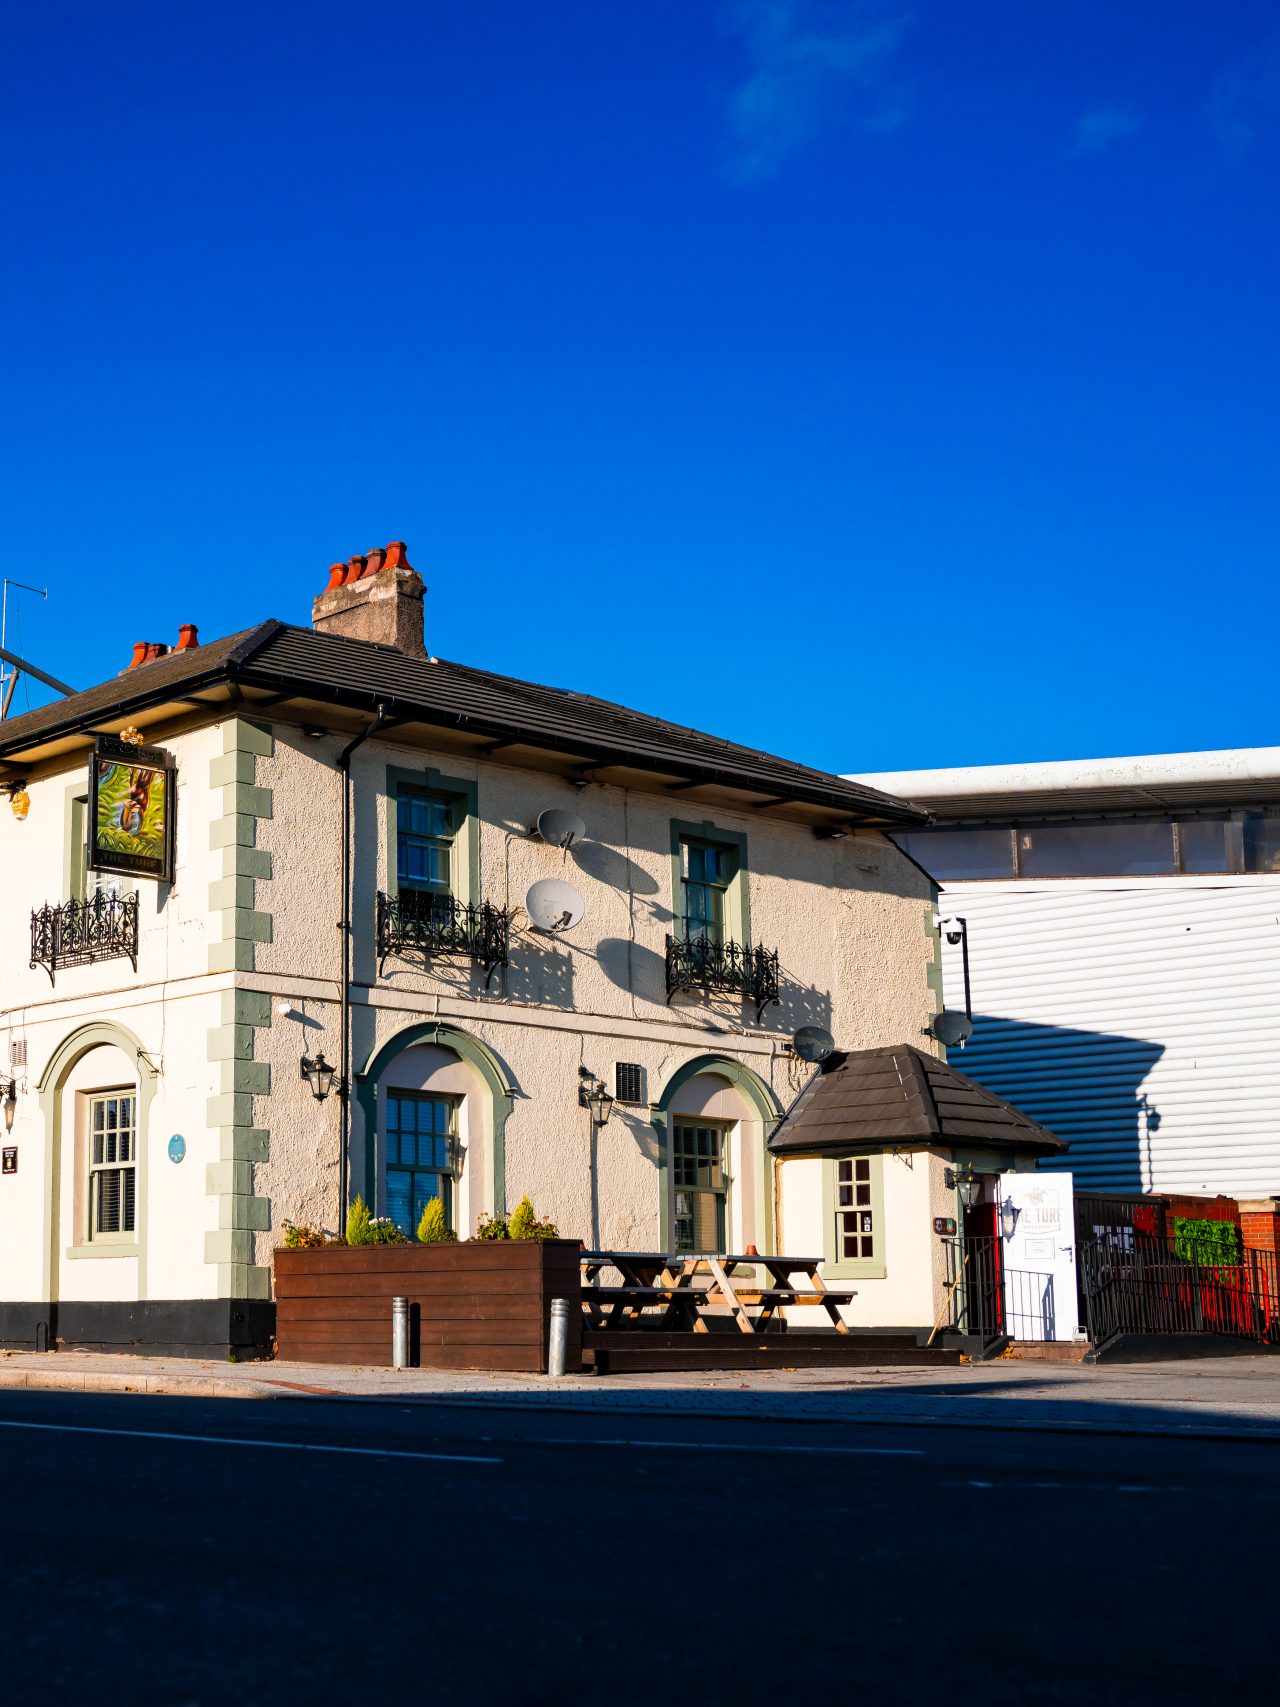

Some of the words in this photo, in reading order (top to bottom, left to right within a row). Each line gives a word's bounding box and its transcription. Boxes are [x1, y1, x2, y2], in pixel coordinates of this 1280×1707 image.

[102, 852, 126, 863] THE
[129, 856, 158, 868] TURF
[1035, 1207, 1063, 1223] TURF
